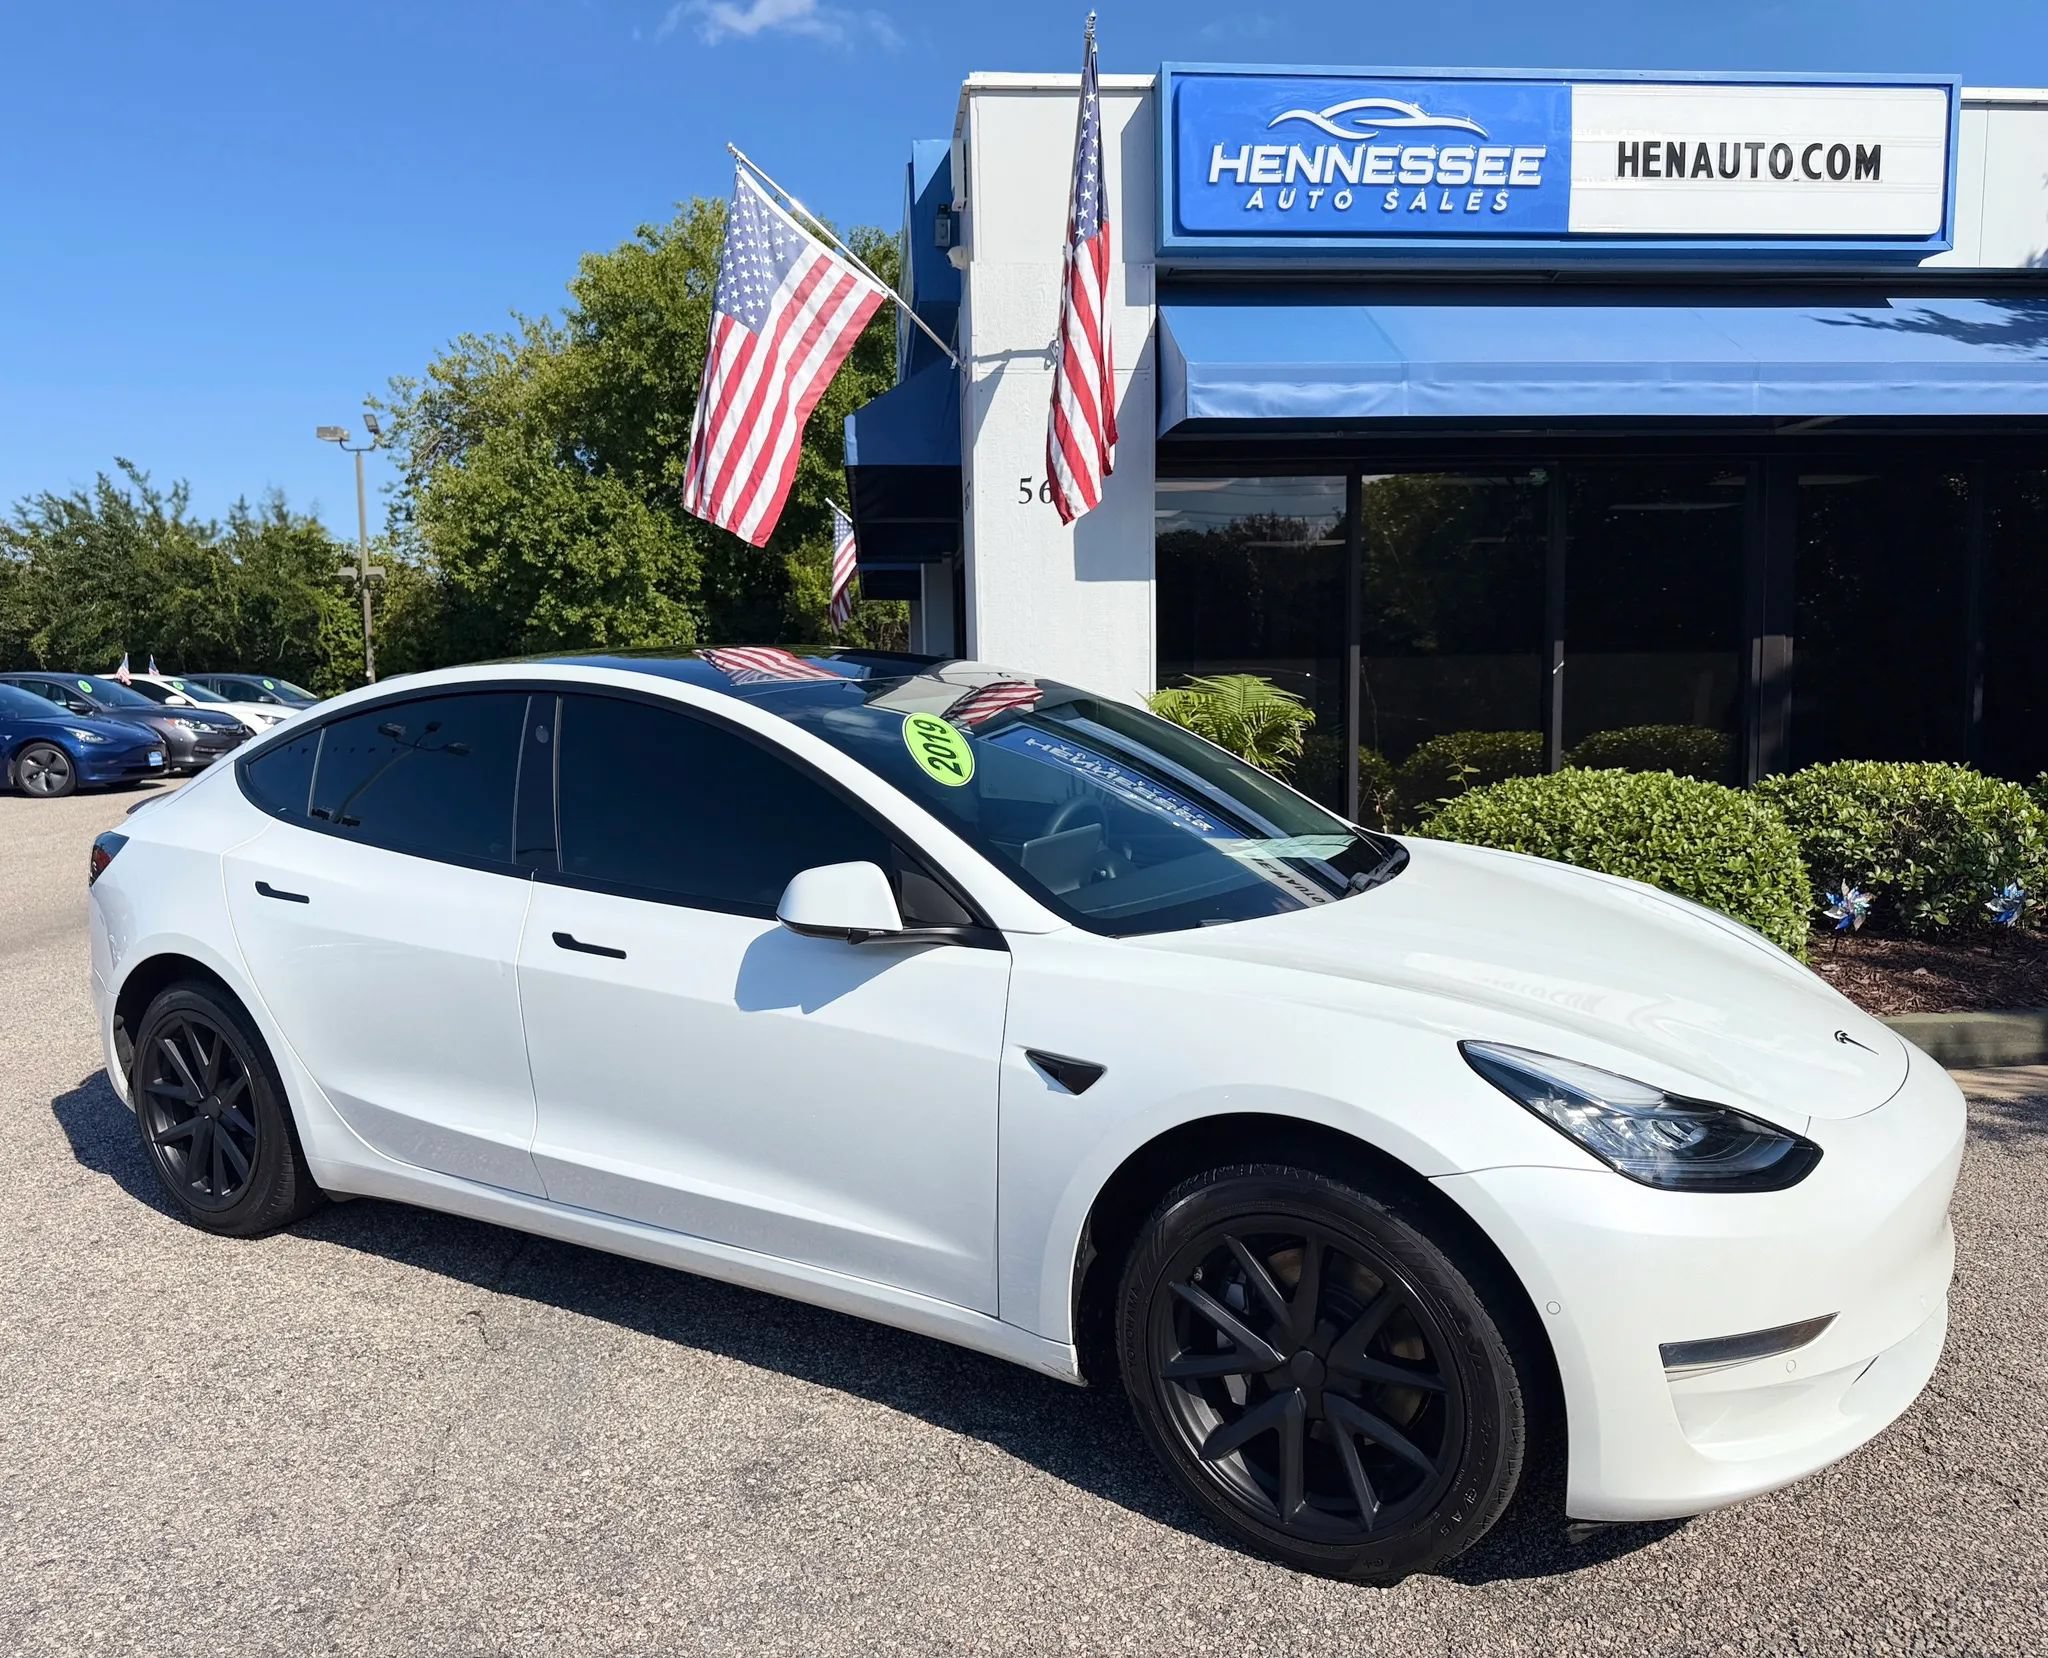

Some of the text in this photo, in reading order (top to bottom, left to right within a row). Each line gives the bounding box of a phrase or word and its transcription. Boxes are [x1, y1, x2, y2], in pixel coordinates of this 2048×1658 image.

[1208, 144, 1547, 186] HENNESSEE
[1617, 141, 1882, 182] HENAUTO.COM
[1245, 188, 1510, 212] AUTO SALES
[913, 719, 963, 777] 2019
[1125, 1286, 1138, 1369] YOKOHAMA
